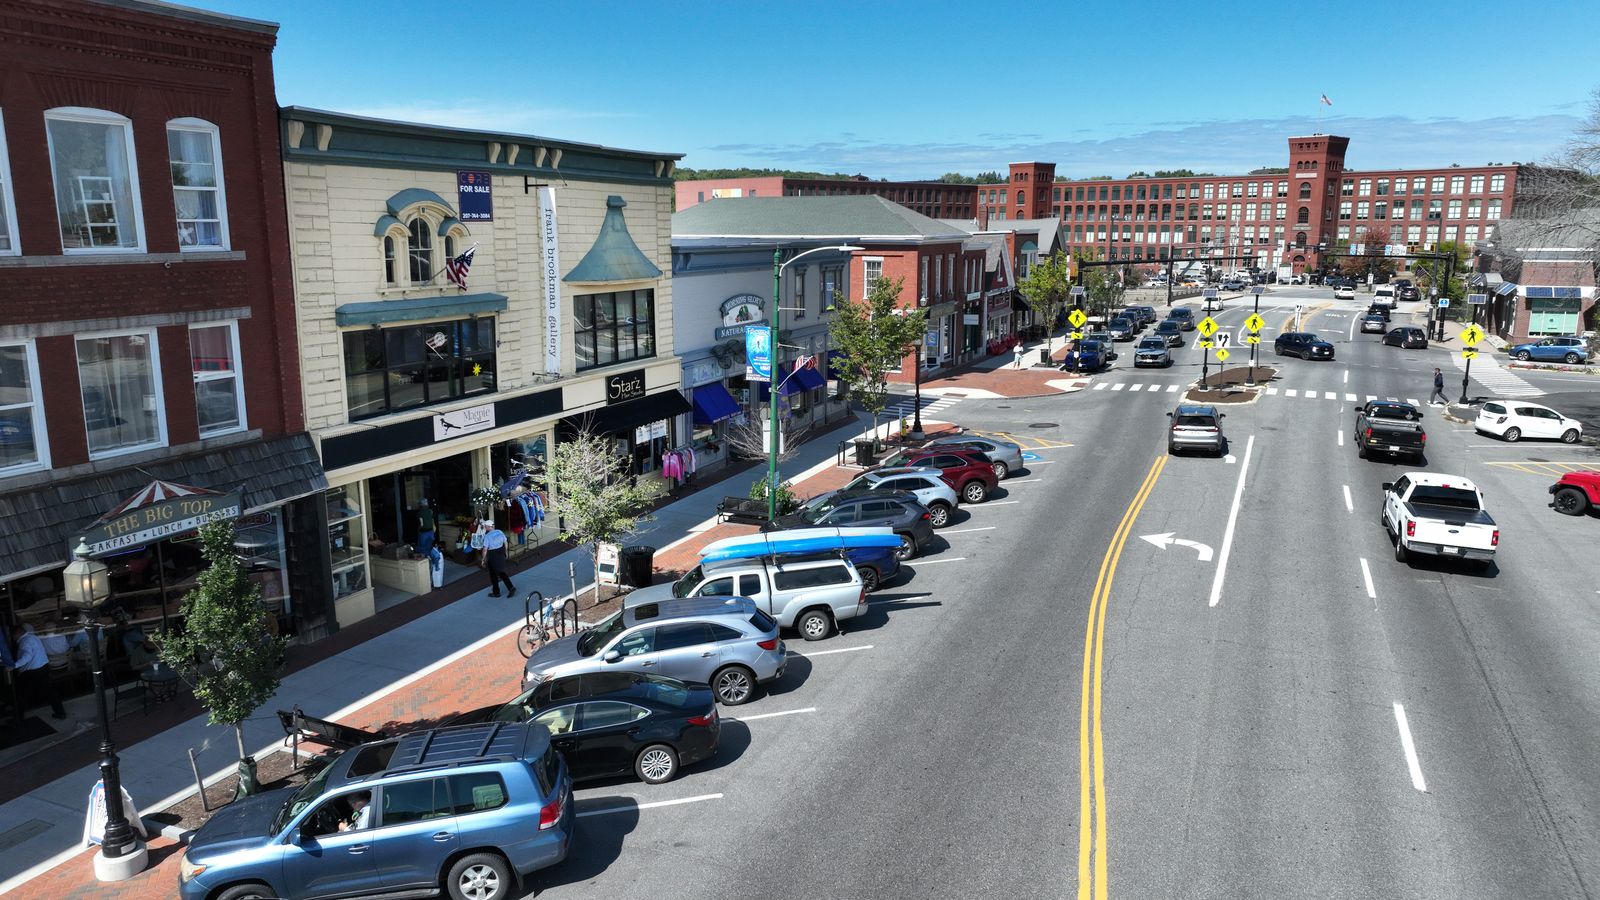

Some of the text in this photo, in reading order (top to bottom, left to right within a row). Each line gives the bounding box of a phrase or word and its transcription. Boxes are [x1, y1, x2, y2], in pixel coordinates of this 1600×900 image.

[460, 184, 490, 194] FOR SALE
[545, 208, 558, 358] frank brockman gallery
[104, 499, 212, 538] THE BIG TOP
[89, 533, 137, 553] EAKFAST
[152, 521, 183, 537] LUNCH
